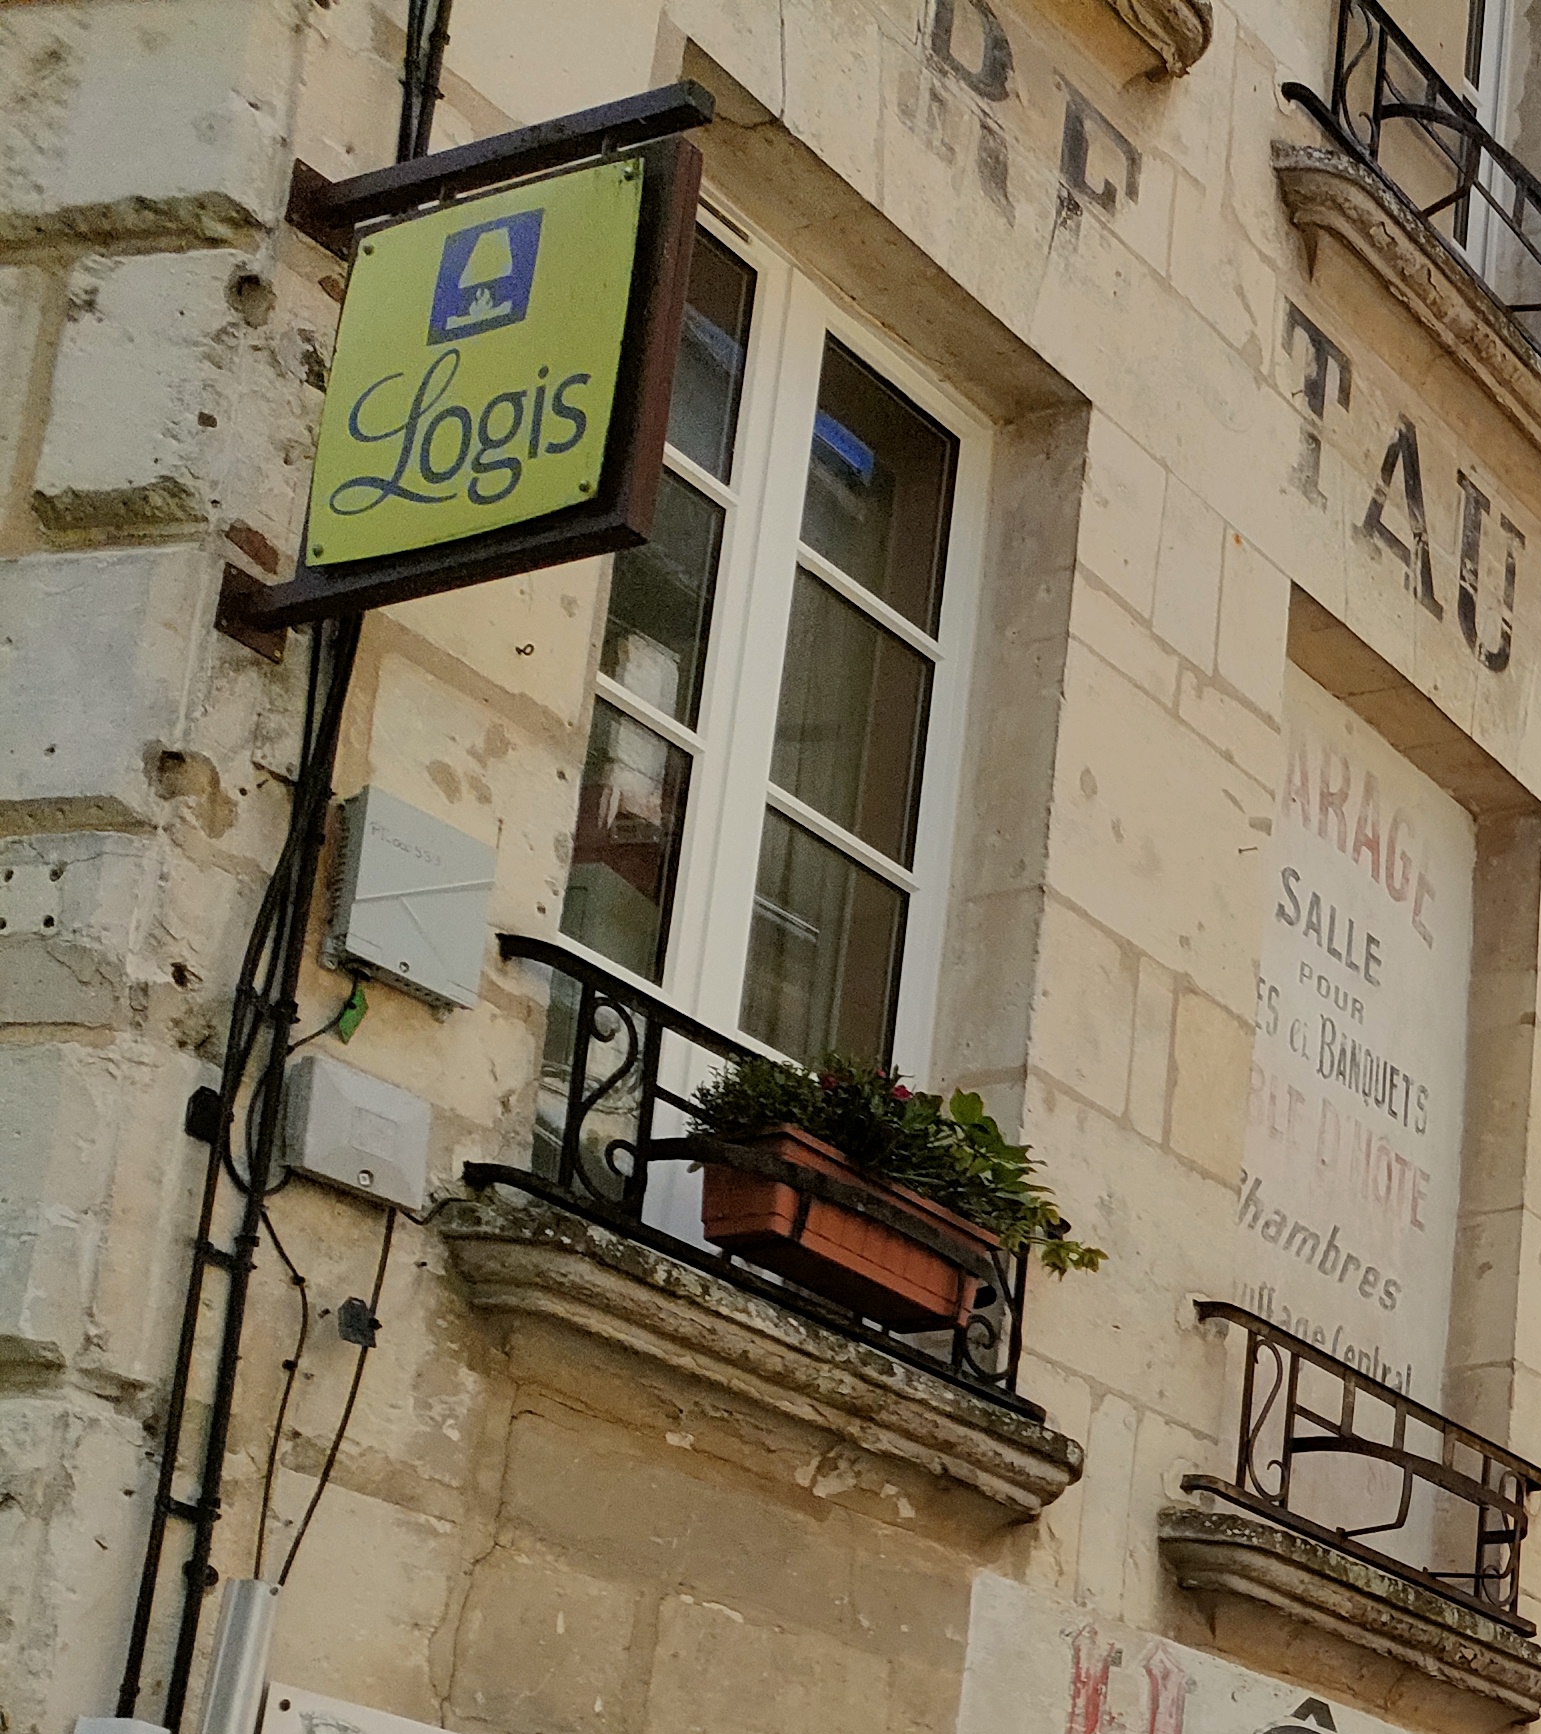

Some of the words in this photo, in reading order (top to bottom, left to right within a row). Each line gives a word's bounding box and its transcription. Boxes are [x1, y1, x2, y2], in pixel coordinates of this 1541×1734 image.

[329, 348, 591, 515] Logis
[1275, 866, 1382, 988] SALLE
[1299, 961, 1365, 1025] POUR
[1316, 1014, 1430, 1135] BANQUETS
